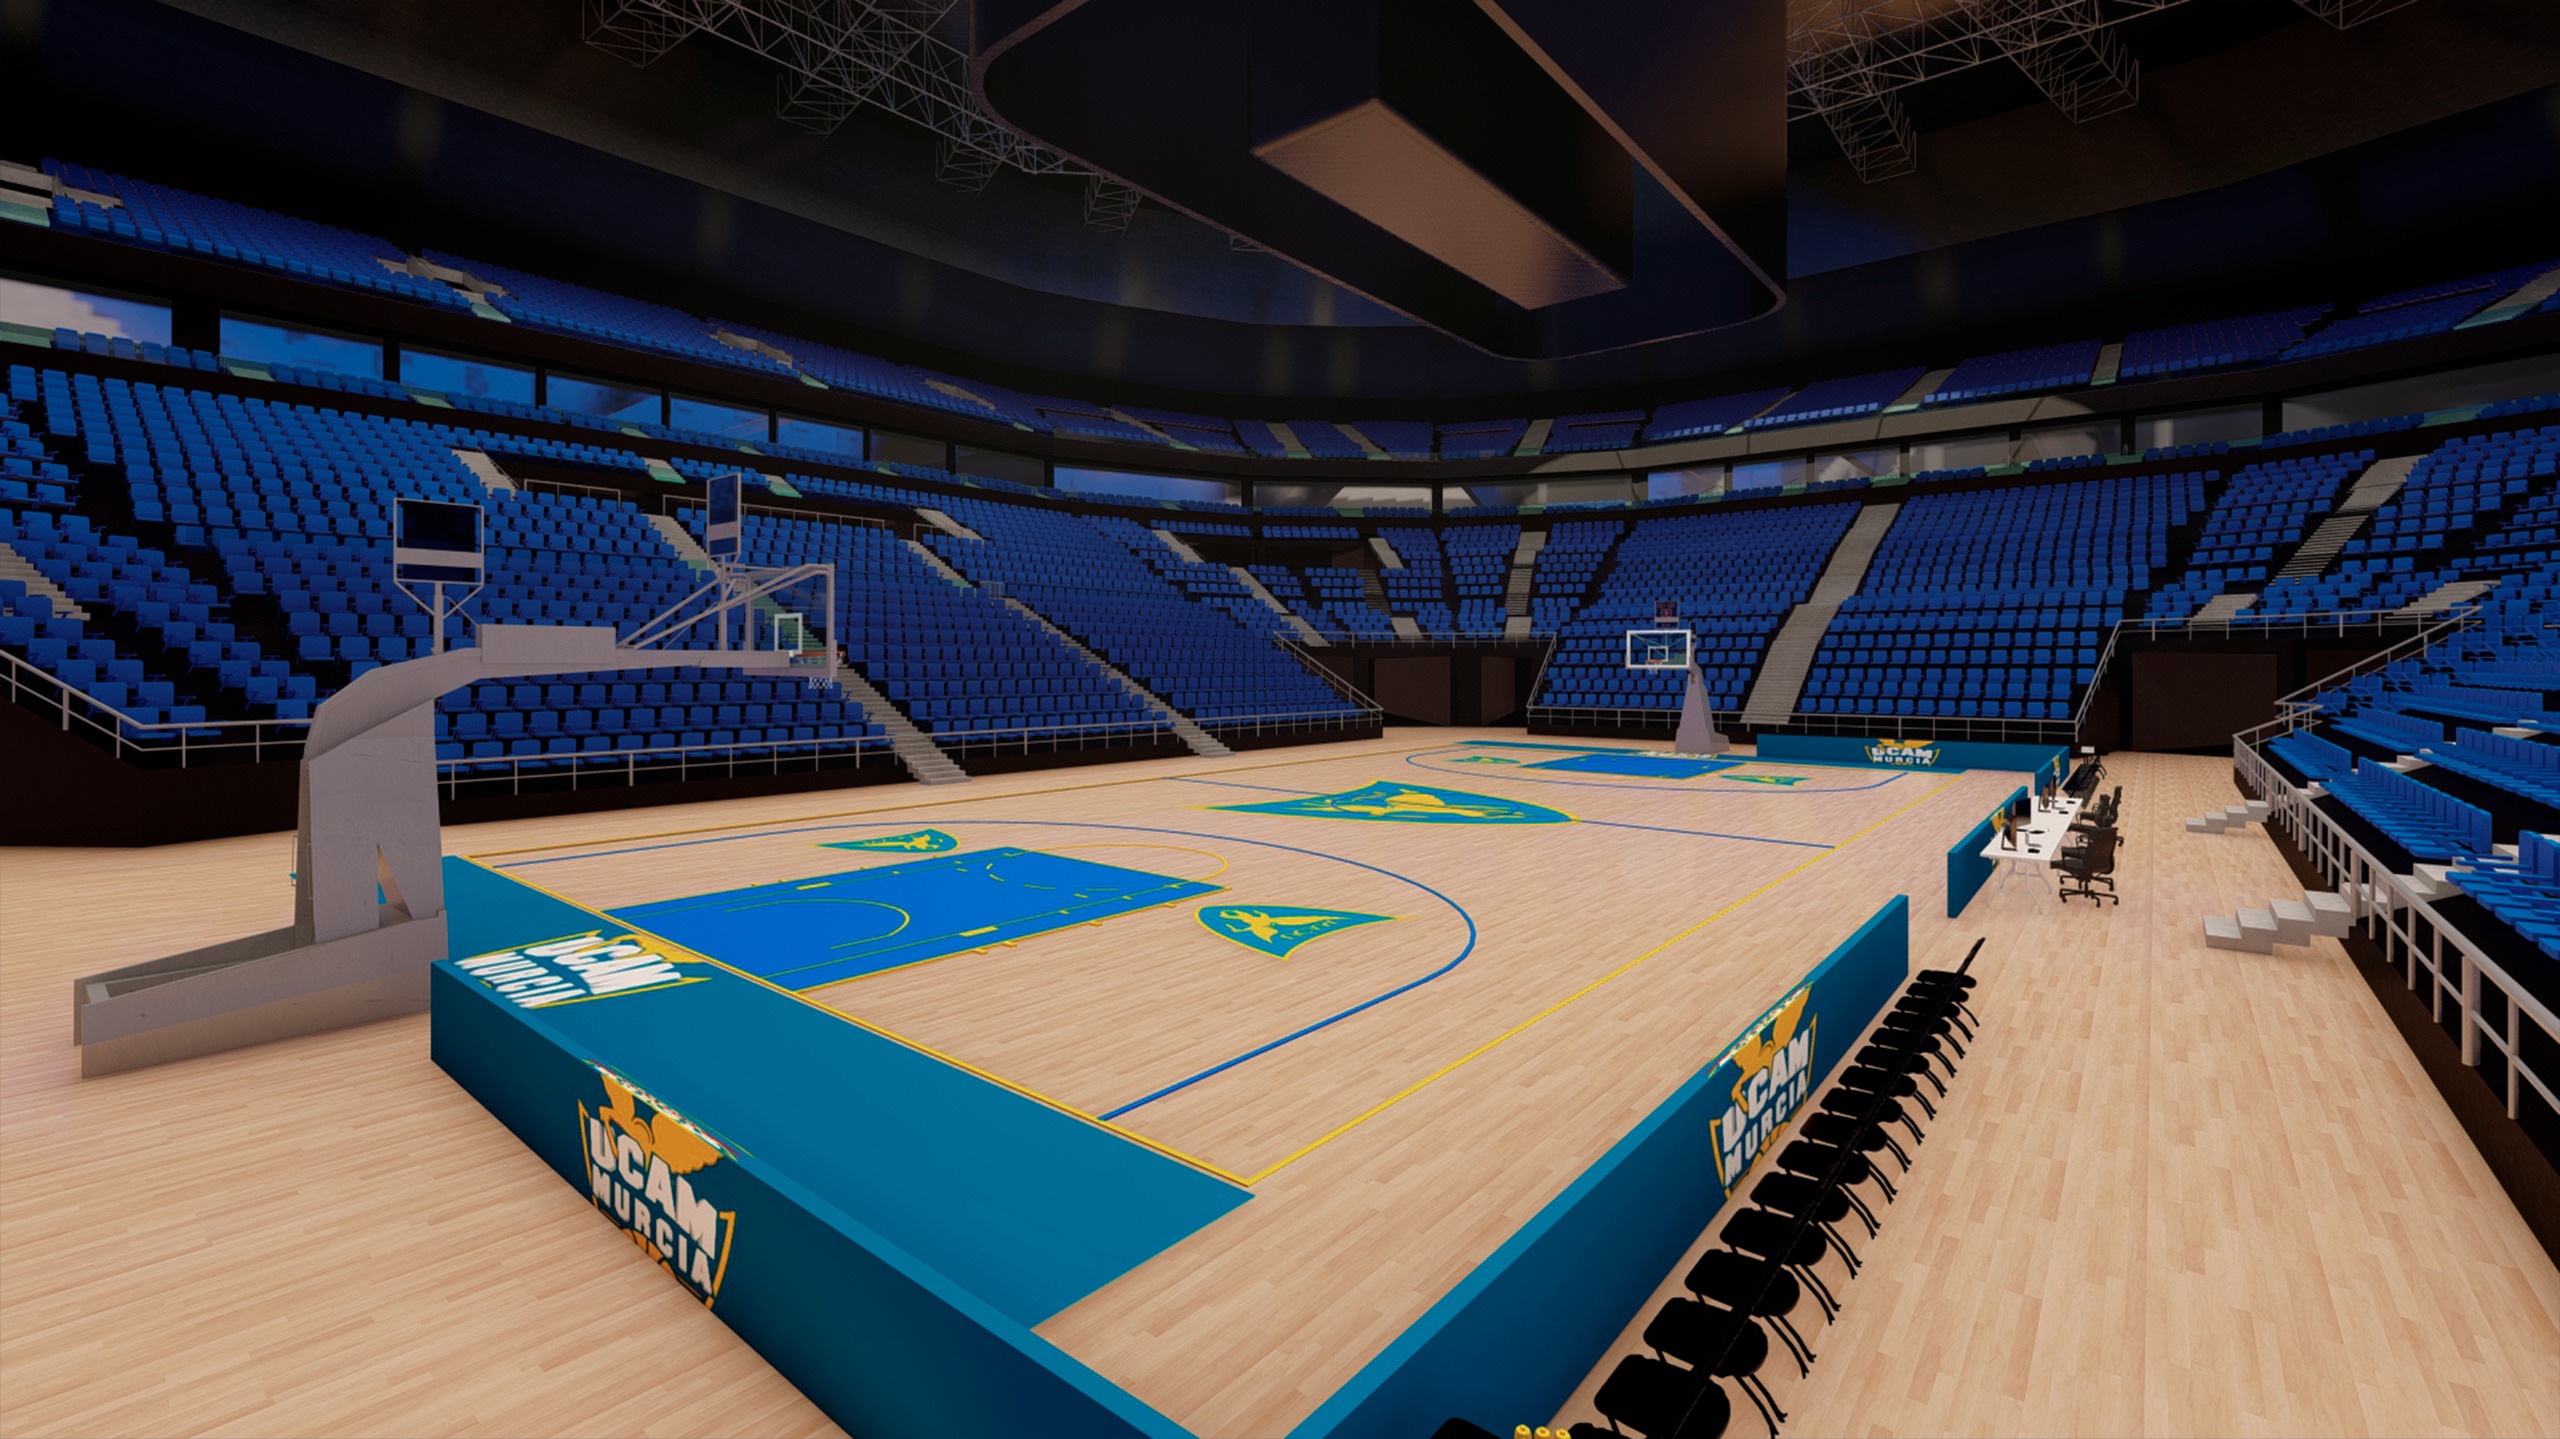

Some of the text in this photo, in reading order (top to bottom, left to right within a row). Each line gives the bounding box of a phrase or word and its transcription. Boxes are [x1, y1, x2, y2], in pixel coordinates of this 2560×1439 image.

[1872, 747, 1933, 759] UCAM
[1873, 756, 1931, 765] MURCIA
[454, 951, 587, 1009] MURCIA
[523, 936, 682, 995] UCAM
[1722, 1028, 1810, 1153] UCAM
[1725, 1069, 1807, 1188] MURCIA
[589, 1117, 718, 1261] UCAM
[592, 1163, 713, 1295] MURCIA
